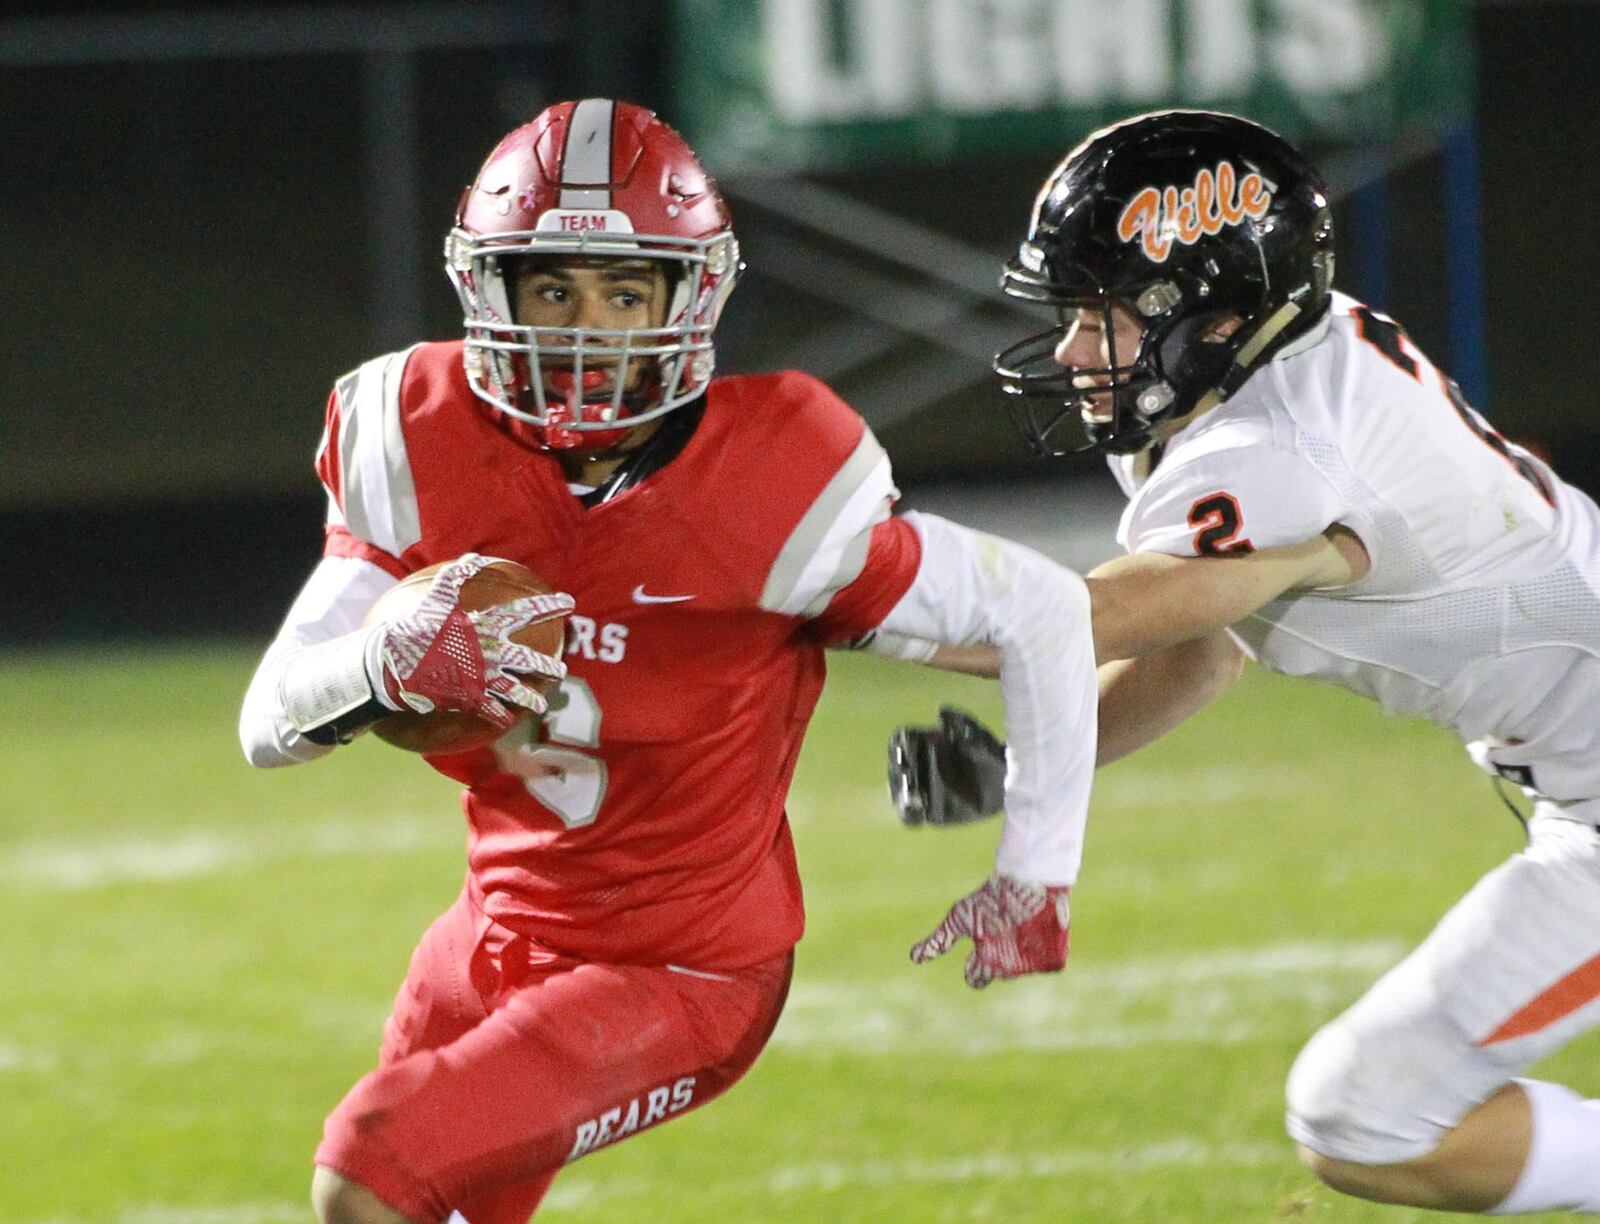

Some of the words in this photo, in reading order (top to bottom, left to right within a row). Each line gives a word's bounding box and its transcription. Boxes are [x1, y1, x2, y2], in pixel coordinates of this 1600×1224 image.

[559, 215, 607, 231] TEAM
[1118, 162, 1270, 262] Ville
[1187, 490, 1254, 557] 2
[567, 1078, 696, 1161] BEARS
